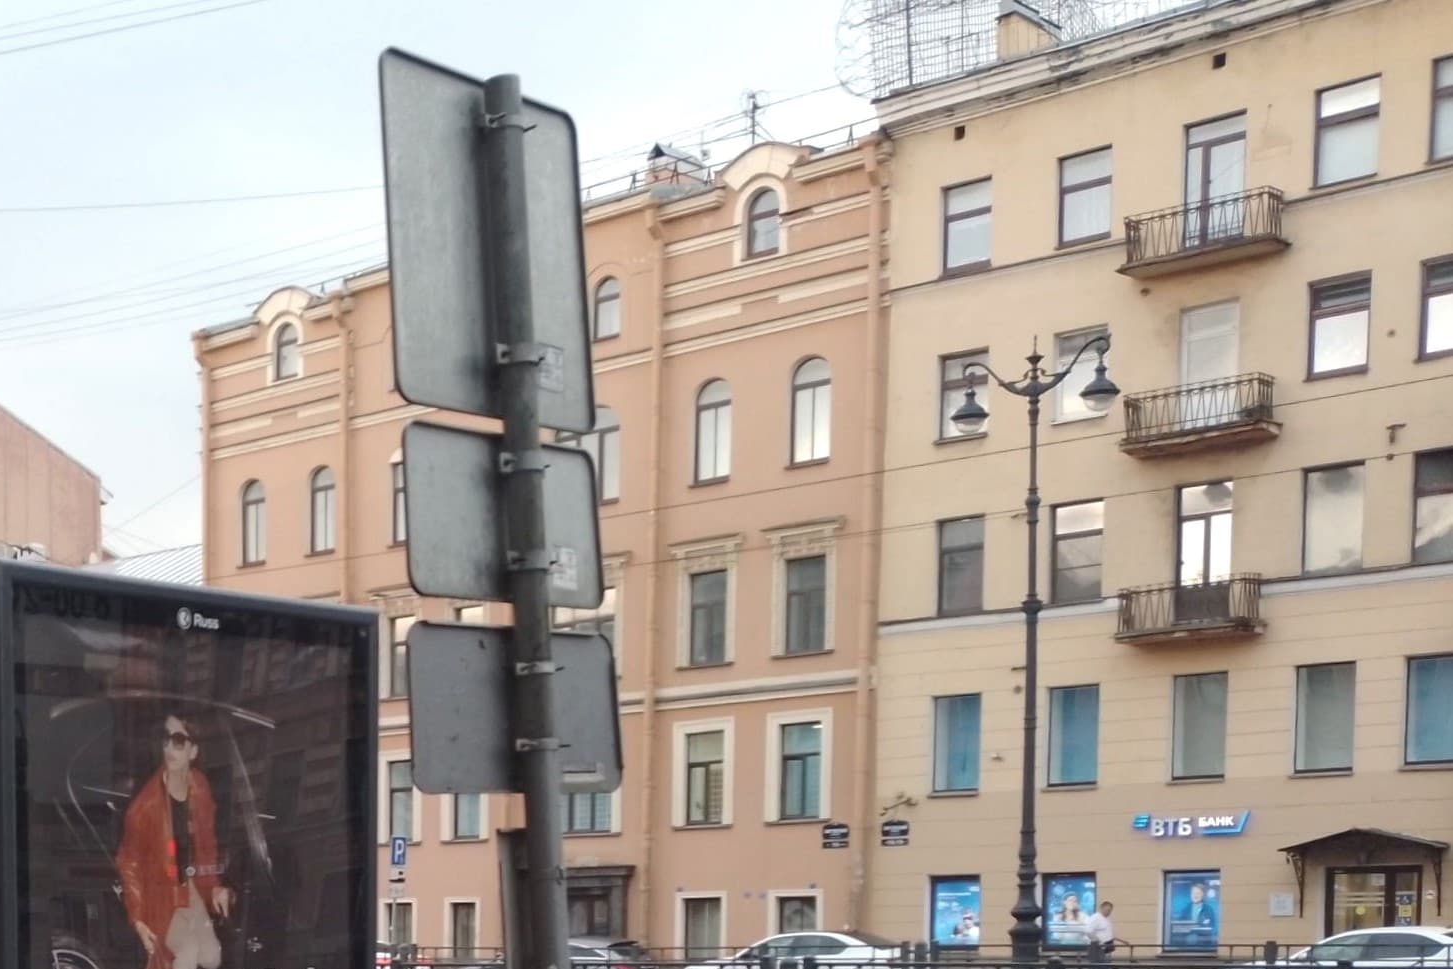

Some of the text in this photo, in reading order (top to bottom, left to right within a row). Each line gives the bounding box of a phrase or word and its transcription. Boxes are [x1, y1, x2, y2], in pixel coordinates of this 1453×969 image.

[193, 613, 220, 630] Russ
[1150, 815, 1235, 837] ВТБ БАНК
